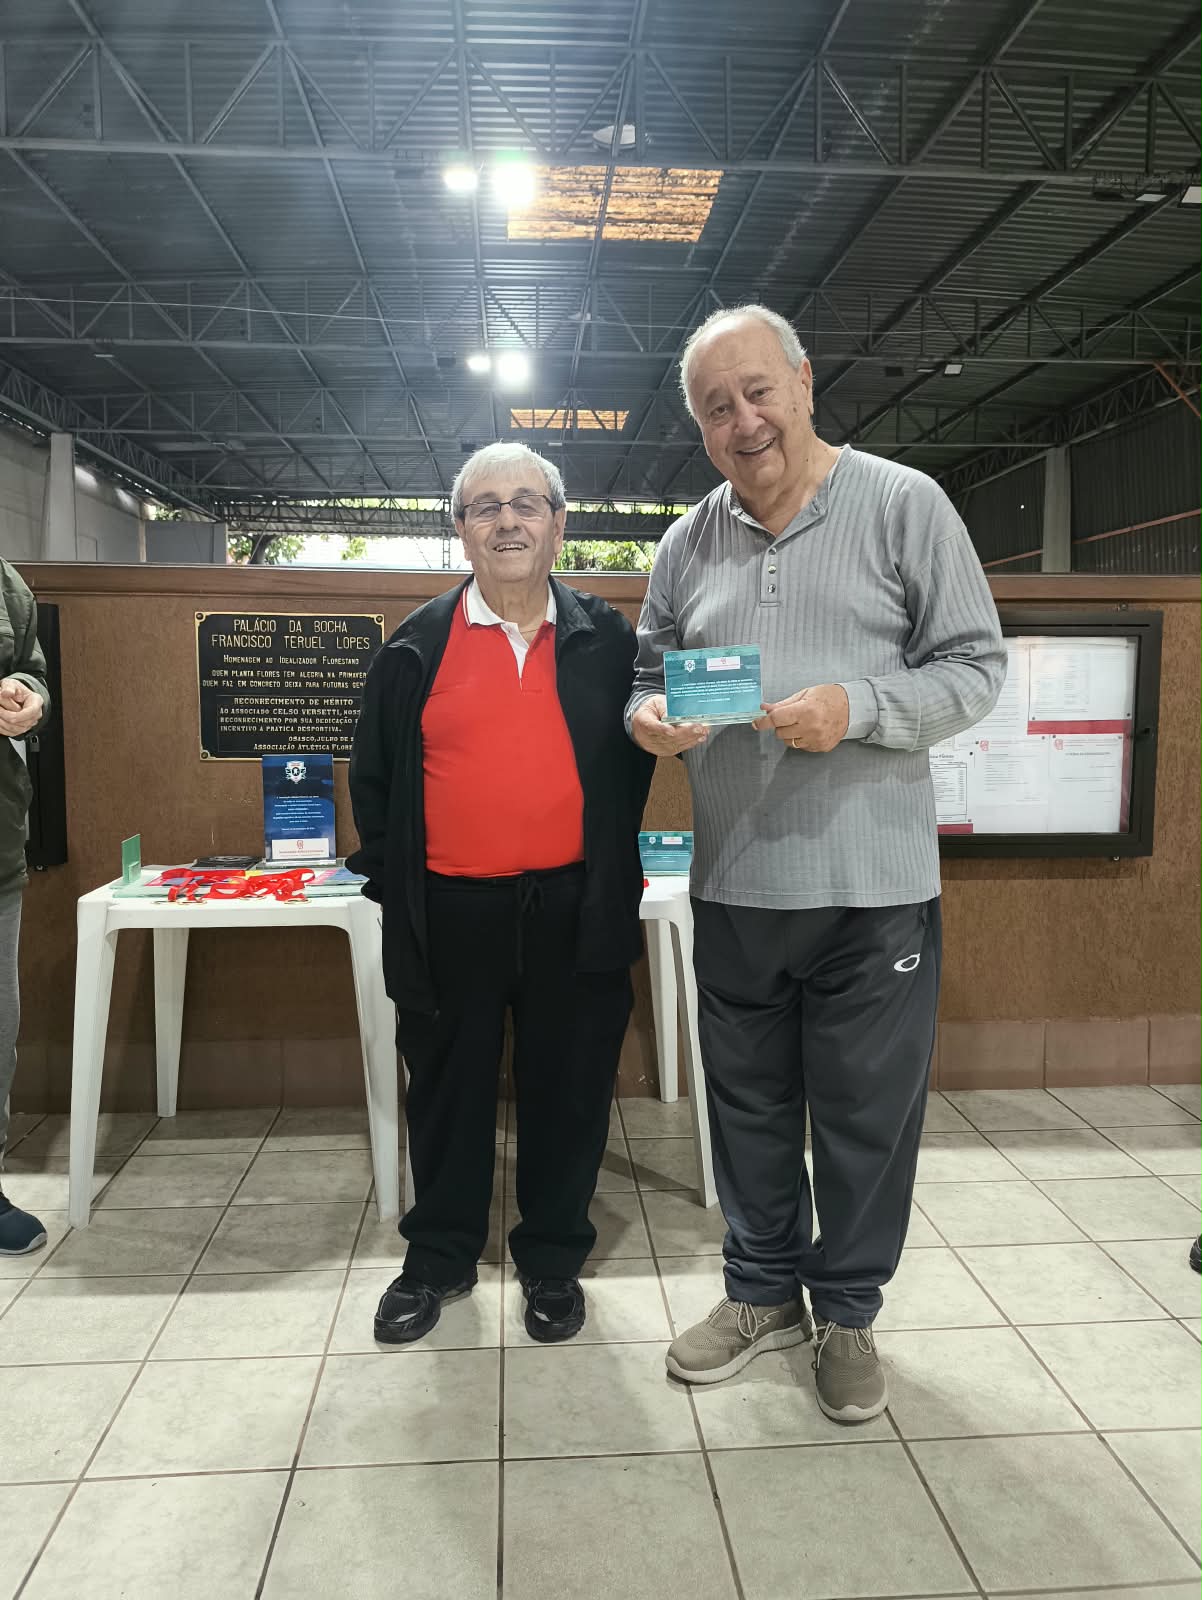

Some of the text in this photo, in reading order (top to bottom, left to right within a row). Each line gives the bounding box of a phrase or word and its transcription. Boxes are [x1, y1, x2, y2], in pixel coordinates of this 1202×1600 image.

[234, 618, 348, 633] PALÁCIO DA BOCHA
[212, 635, 370, 649] FRANCISCO TERUEL LOPES
[316, 716, 352, 724] DEDICAÇÃO
[254, 743, 295, 751] ASSOCIAÇÃO
